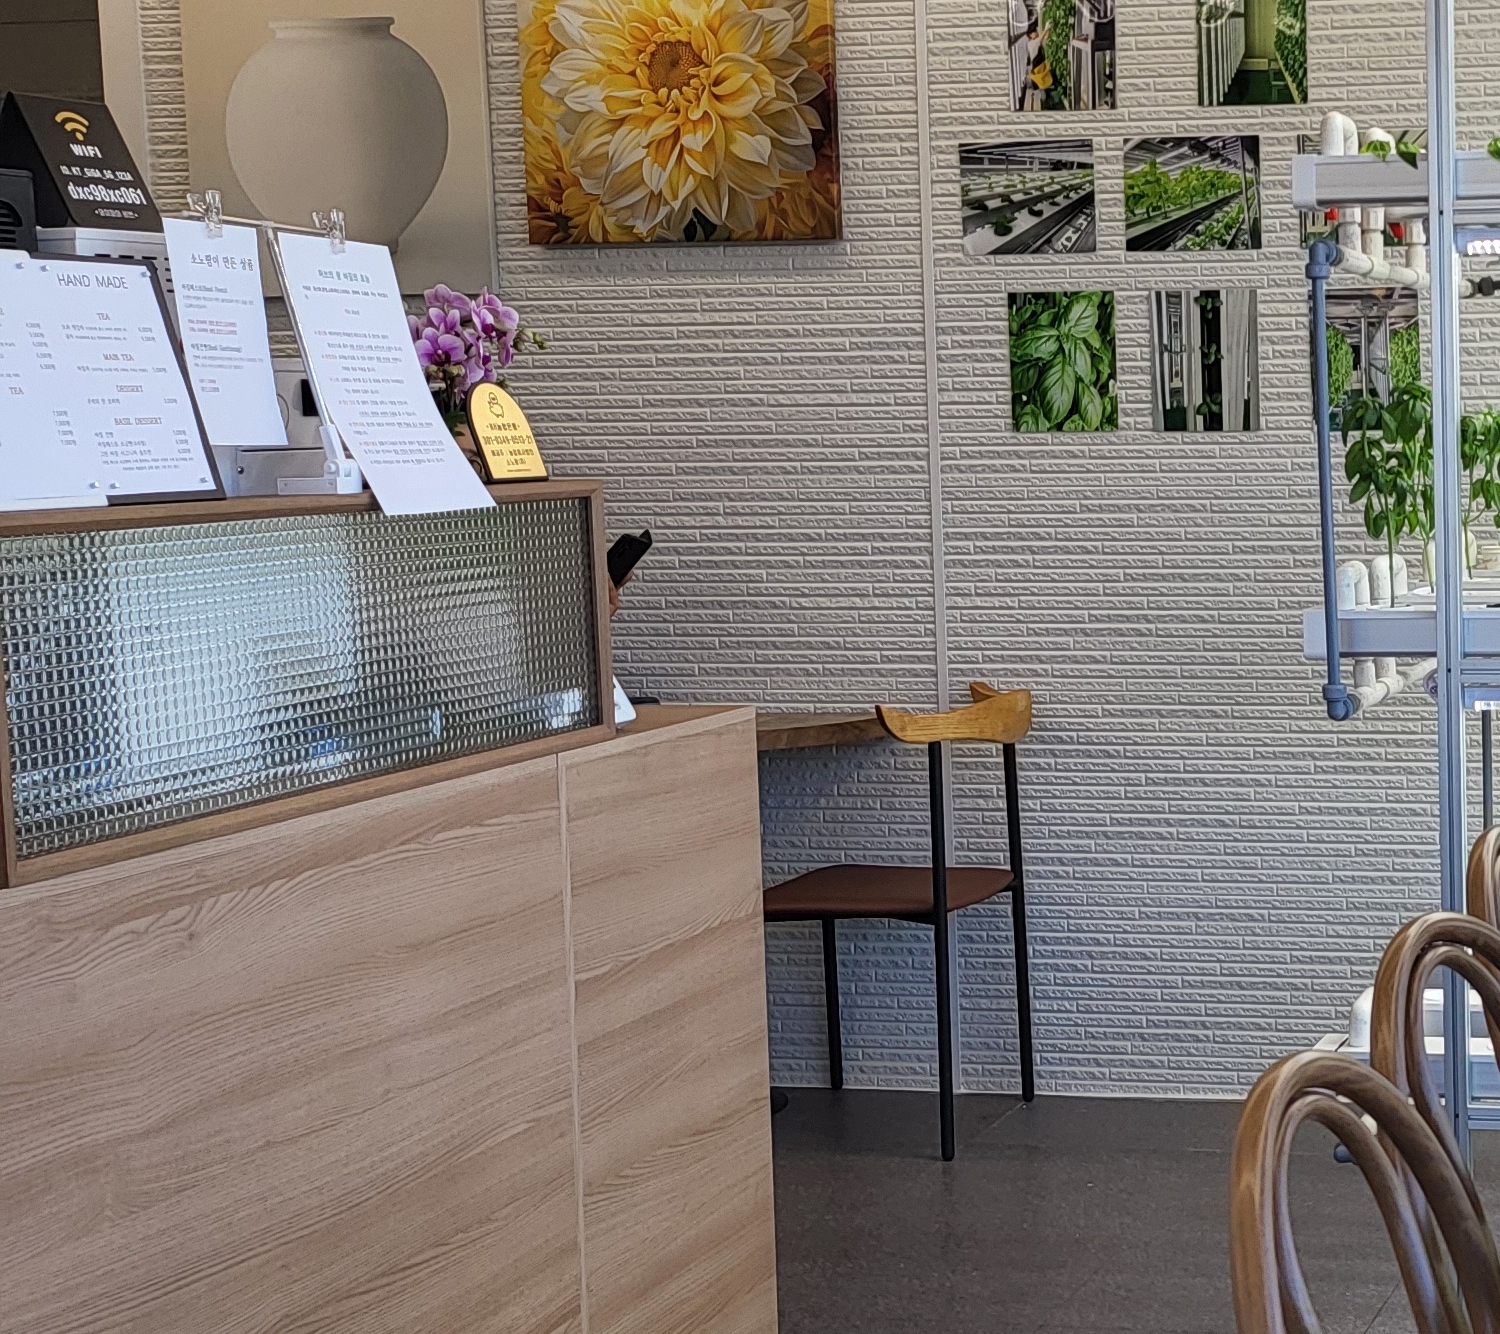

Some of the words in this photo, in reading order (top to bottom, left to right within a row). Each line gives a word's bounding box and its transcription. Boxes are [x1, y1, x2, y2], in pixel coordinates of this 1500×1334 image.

[69, 143, 103, 159] WIFI
[67, 181, 147, 205] dxc98xc061
[57, 273, 91, 288] HAND
[95, 275, 128, 289] MADE
[96, 312, 111, 321] TEA
[9, 386, 24, 395] TEA
